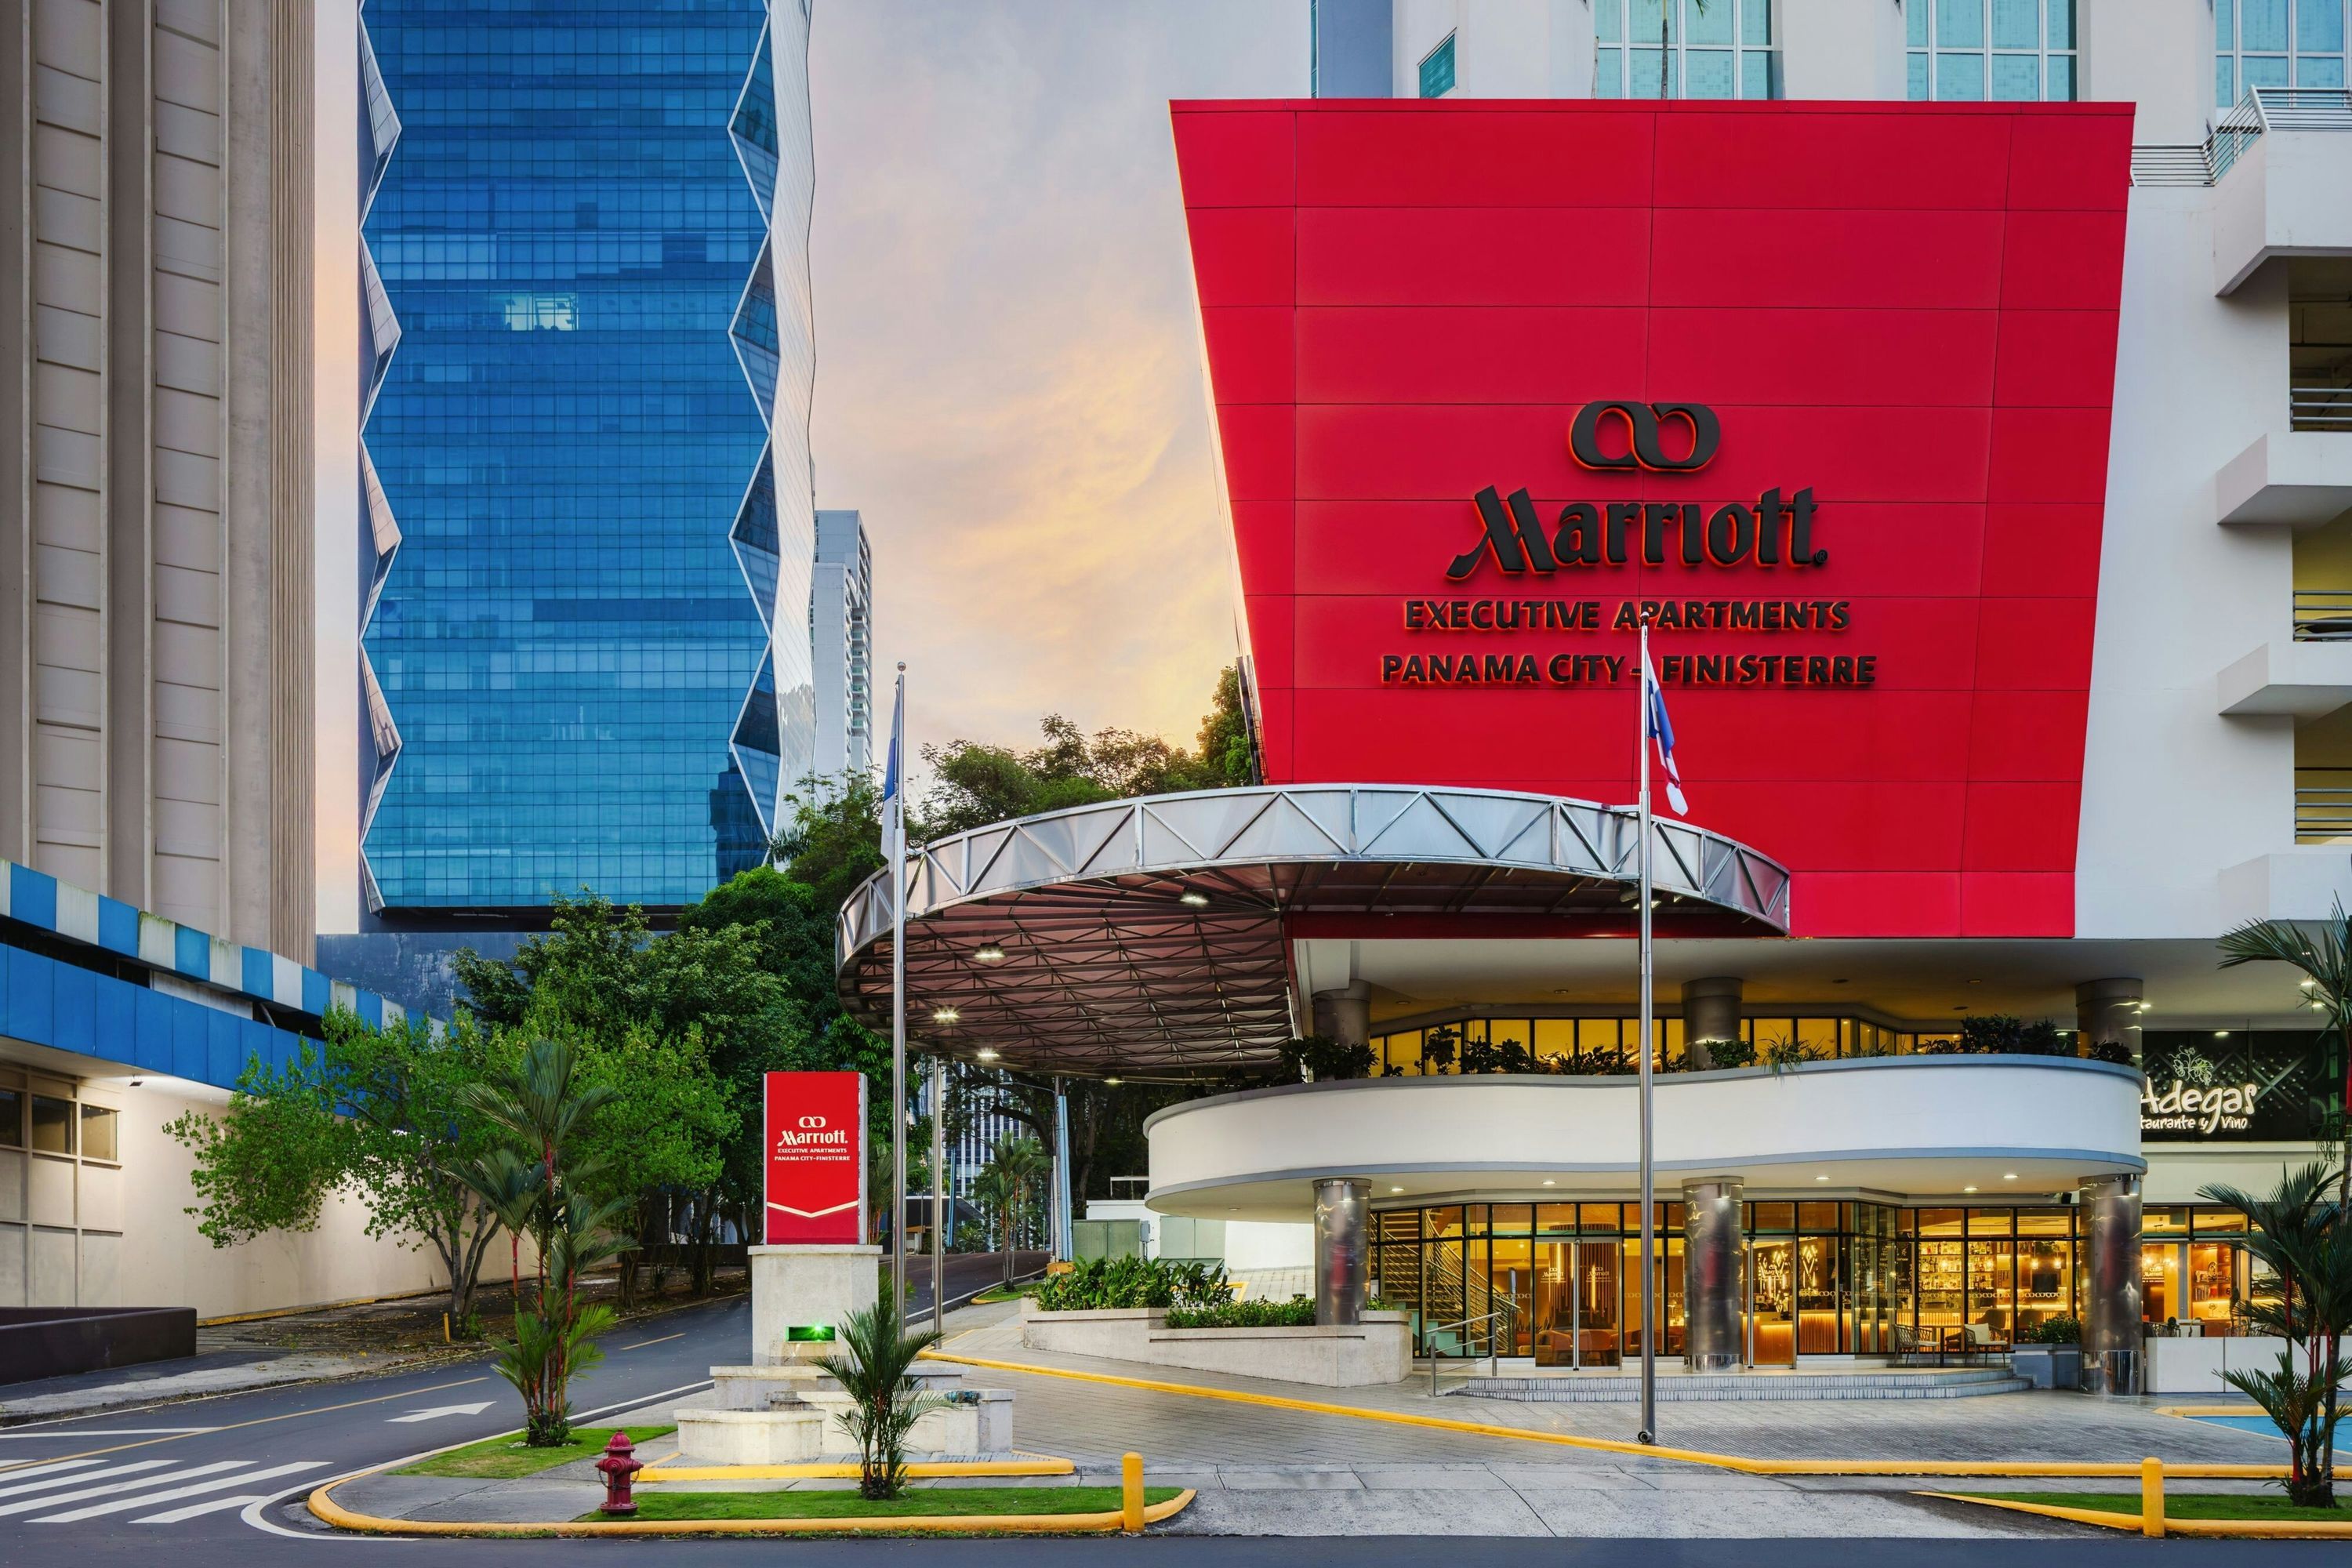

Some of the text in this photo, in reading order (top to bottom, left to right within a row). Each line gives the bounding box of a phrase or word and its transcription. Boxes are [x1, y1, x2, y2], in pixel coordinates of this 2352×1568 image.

[1406, 601, 1850, 630] EXECUTIVE APARTMENTS
[1382, 654, 1541, 683] PANAMA
[1548, 654, 1625, 683] CITY
[1661, 654, 1877, 684] FINISTERRE
[2140, 1076, 2257, 1134] Adegas
[2140, 1115, 2196, 1130] taurante
[2198, 1117, 2209, 1130] y
